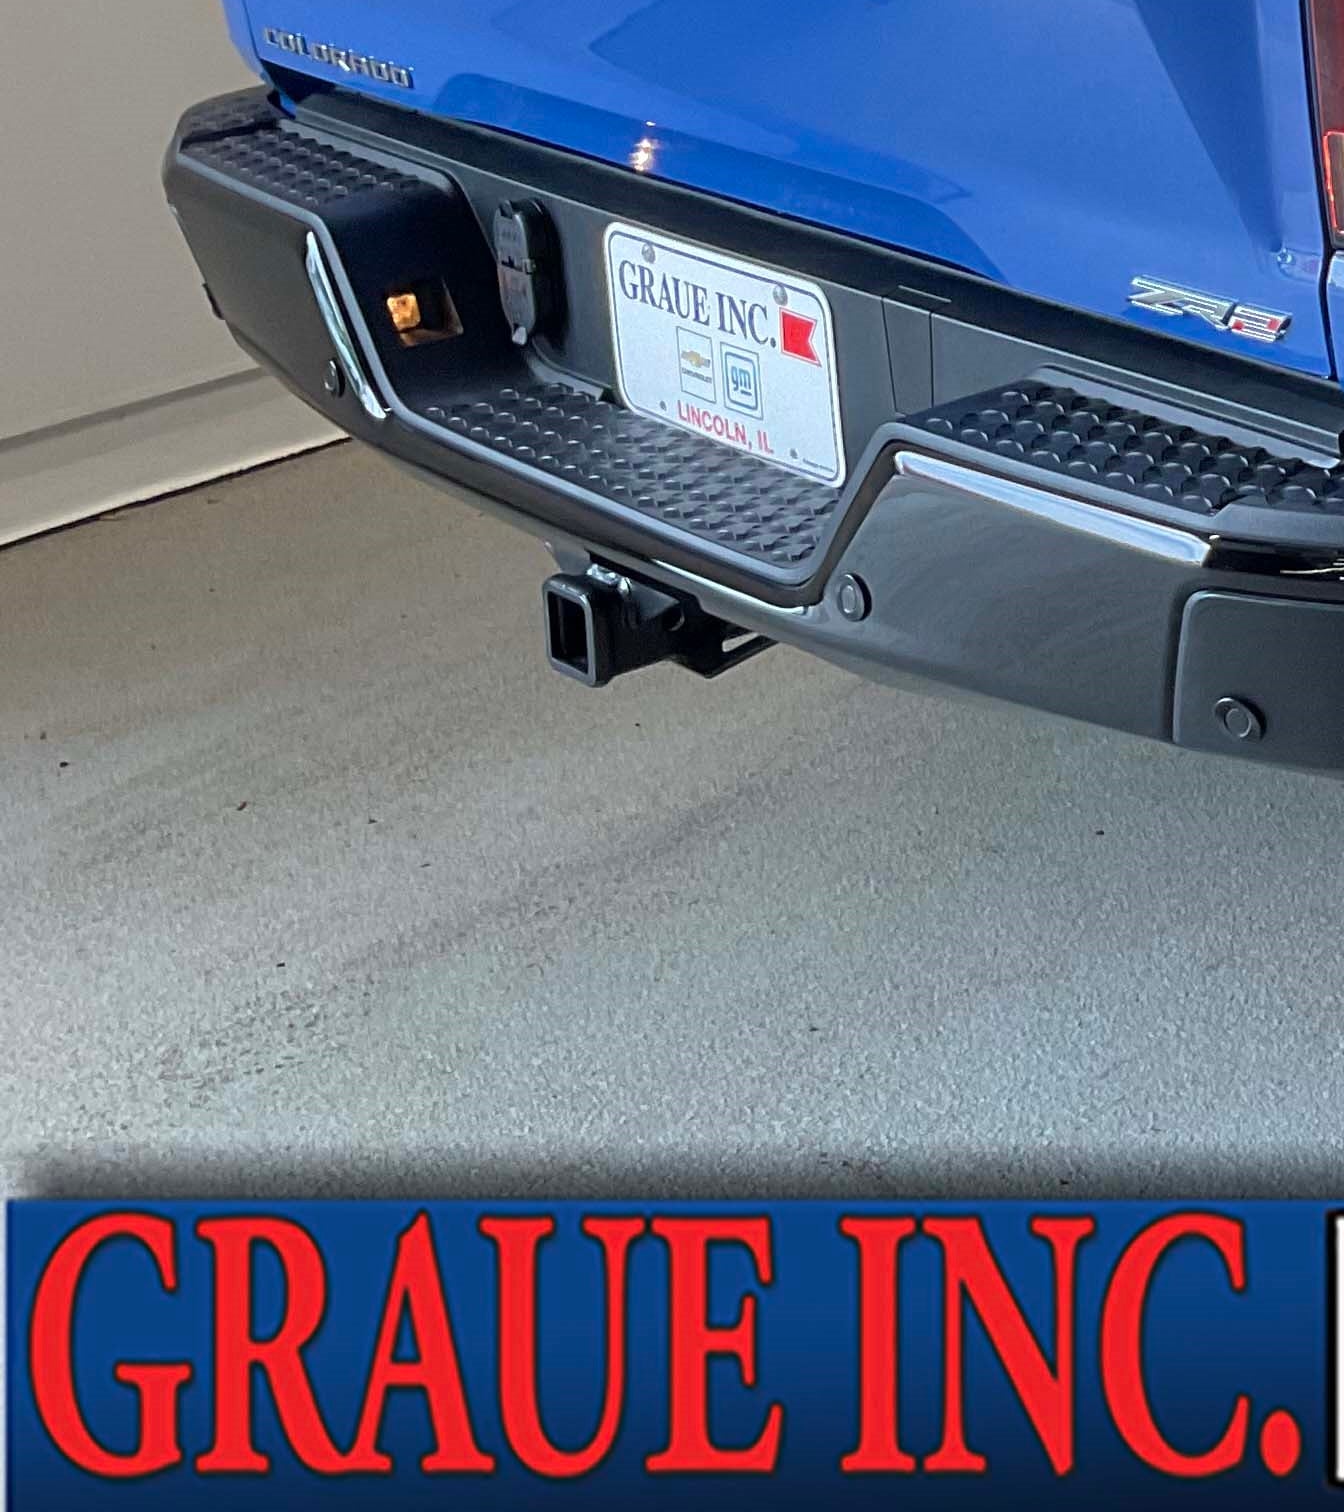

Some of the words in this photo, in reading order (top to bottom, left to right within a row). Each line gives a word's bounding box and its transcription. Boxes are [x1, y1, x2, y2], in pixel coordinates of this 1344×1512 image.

[263, 27, 415, 89] COLORADO
[618, 259, 710, 326] GRAUE
[715, 291, 777, 348] INC.
[1128, 274, 1292, 344] ZR2
[677, 399, 752, 451] LINCOLN,
[757, 429, 774, 454] IL
